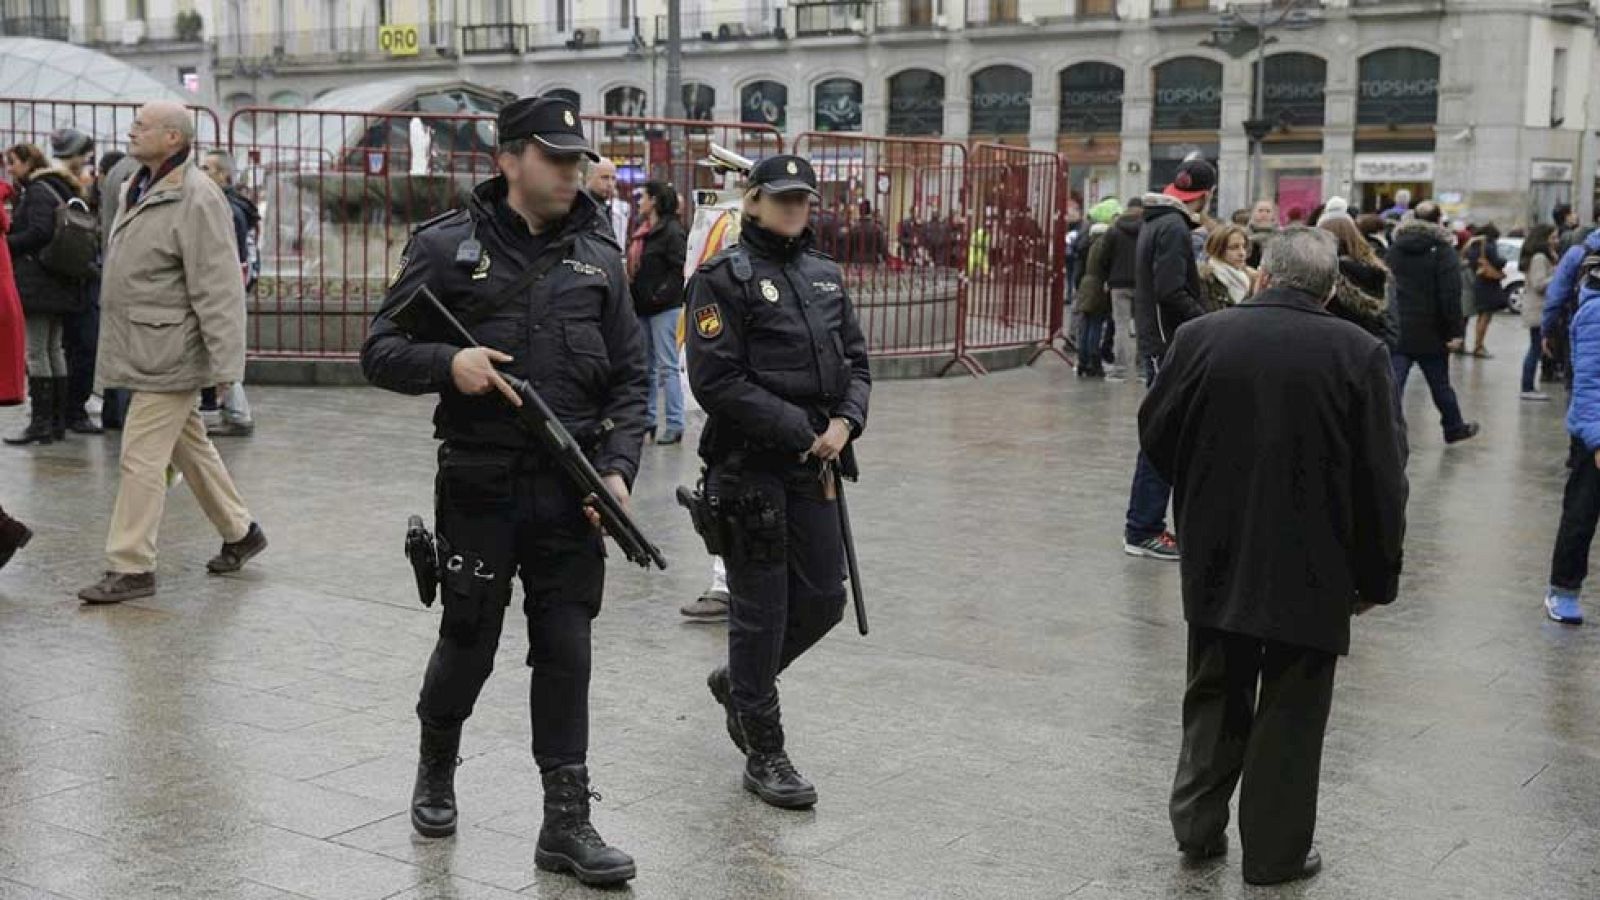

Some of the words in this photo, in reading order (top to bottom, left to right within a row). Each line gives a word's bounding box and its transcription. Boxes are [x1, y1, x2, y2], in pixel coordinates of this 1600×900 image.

[381, 28, 417, 49] ORO
[1264, 82, 1324, 99] OPSHOP
[1361, 79, 1439, 97] TOPSHOP
[1360, 162, 1428, 177] TOPSHOP
